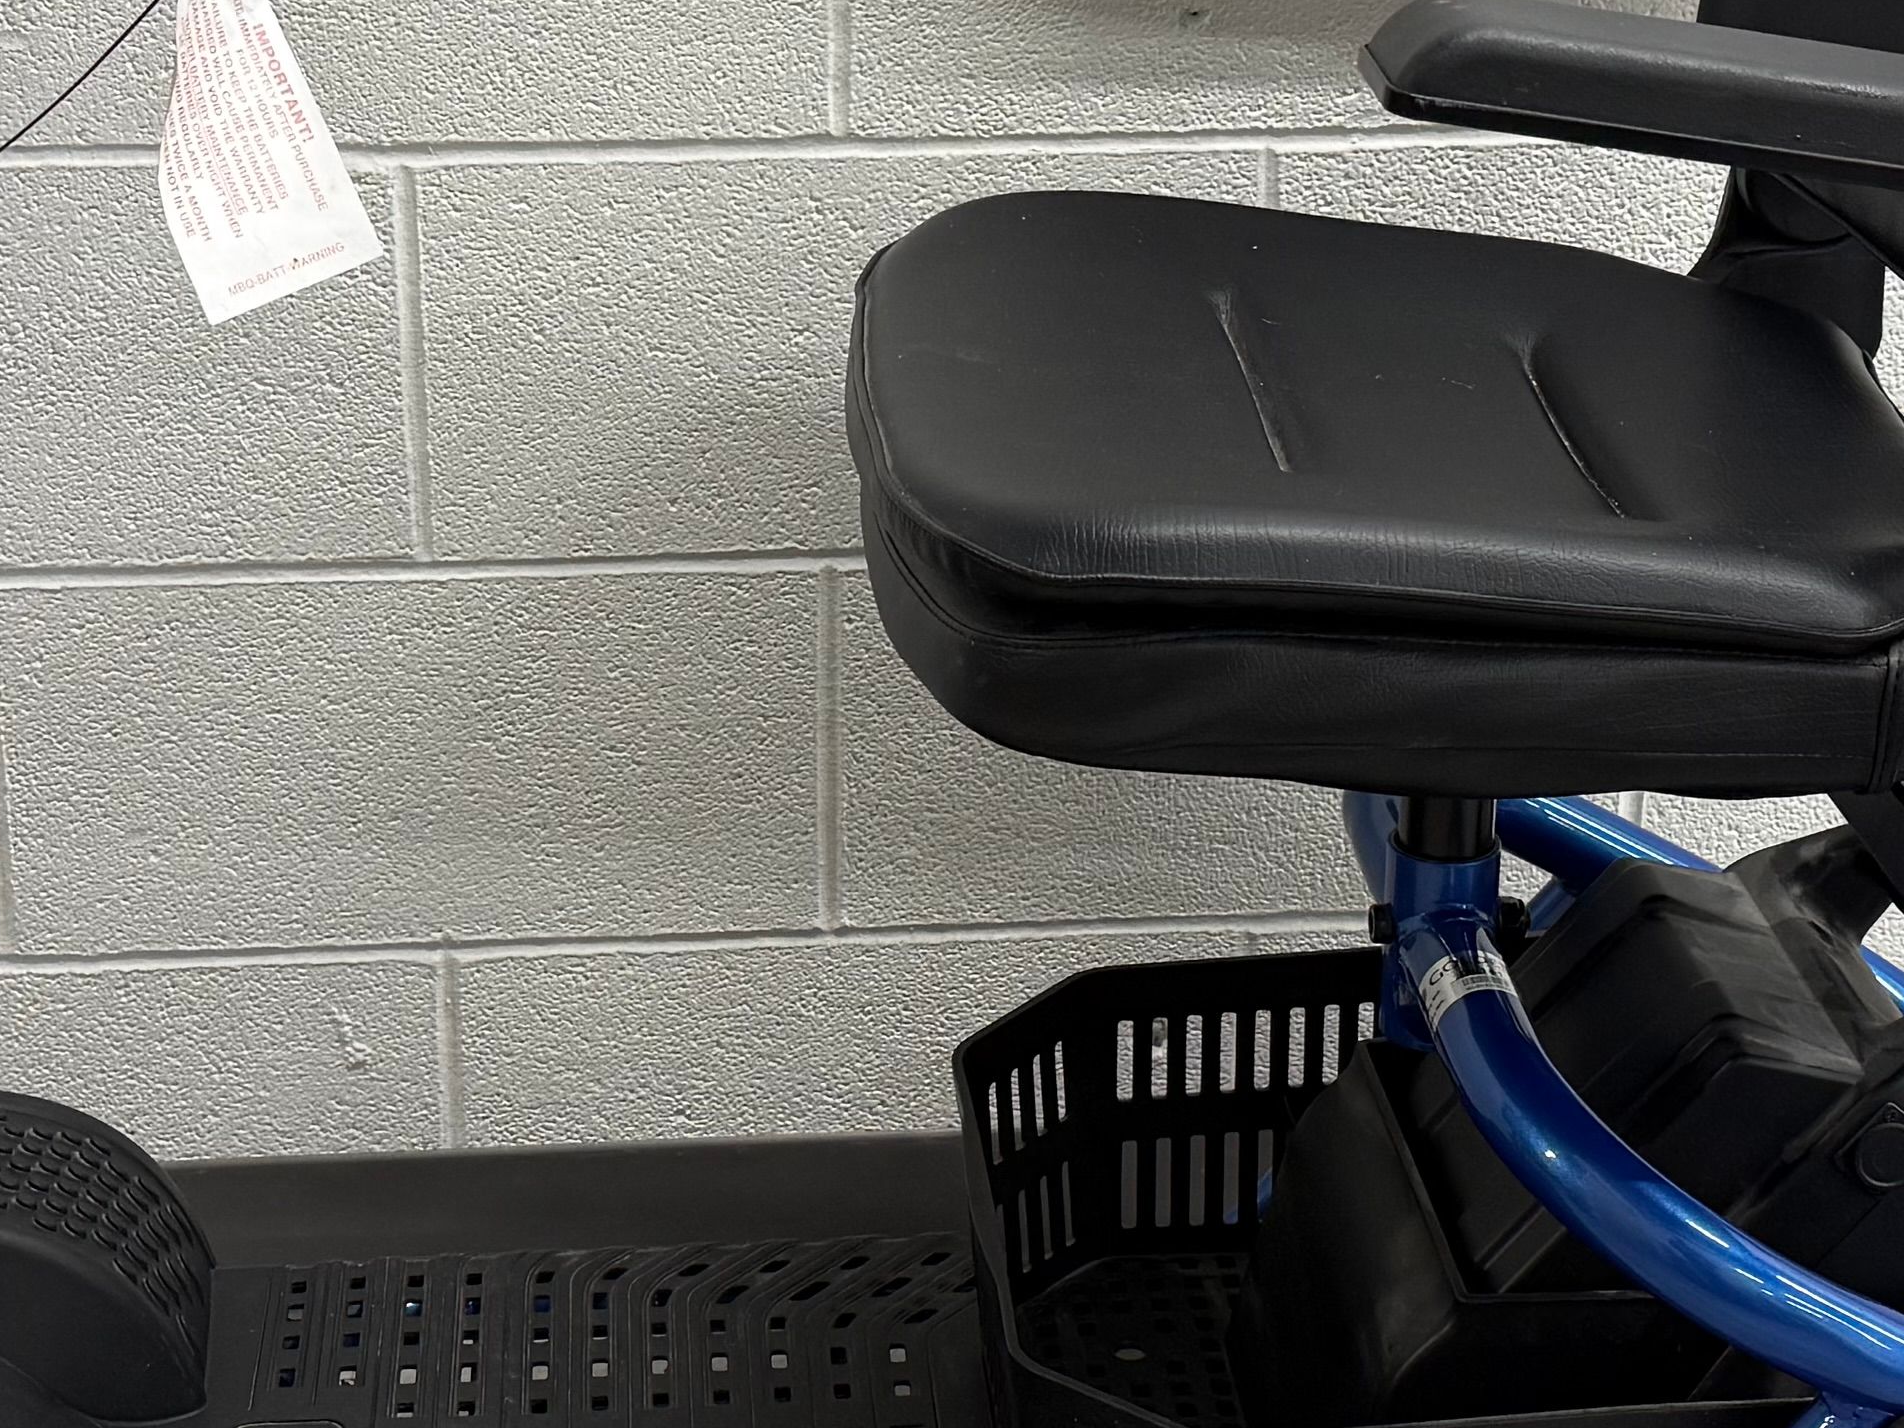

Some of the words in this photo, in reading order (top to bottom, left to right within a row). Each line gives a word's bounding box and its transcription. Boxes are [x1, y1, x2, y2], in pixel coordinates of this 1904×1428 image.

[222, 50, 234, 69] TO
[228, 70, 248, 105] KEEP
[243, 107, 259, 132] THE
[253, 133, 289, 200] BATTERIES
[236, 49, 252, 75] FOR
[247, 78, 258, 92] 12
[254, 93, 280, 139] HOURS
[238, 18, 277, 100] IMMEDIATELY
[273, 103, 297, 142] AFTER
[291, 144, 329, 211] PURCHASE
[252, 23, 315, 143] IMPORTANT!
[171, 140, 189, 181] TWICE
[177, 106, 206, 182] REGULARLY
[189, 65, 210, 122] BATTERY
[205, 124, 249, 216] MAINTENANCE
[200, 55, 213, 83] AND
[208, 86, 224, 117] VOID
[219, 118, 235, 144] THE
[229, 146, 266, 216] WARRANTY
[211, 56, 227, 88] WILL
[221, 90, 245, 134] CAUSE
[239, 135, 279, 212] PERMANENT
[166, 166, 180, 193] NOT
[174, 195, 185, 210] IN
[179, 211, 196, 238] USE
[183, 184, 193, 194] A
[187, 195, 213, 242] MONTH
[191, 122, 210, 157] OVER
[205, 159, 226, 199] NIGHT
[221, 201, 244, 239] WHEN
